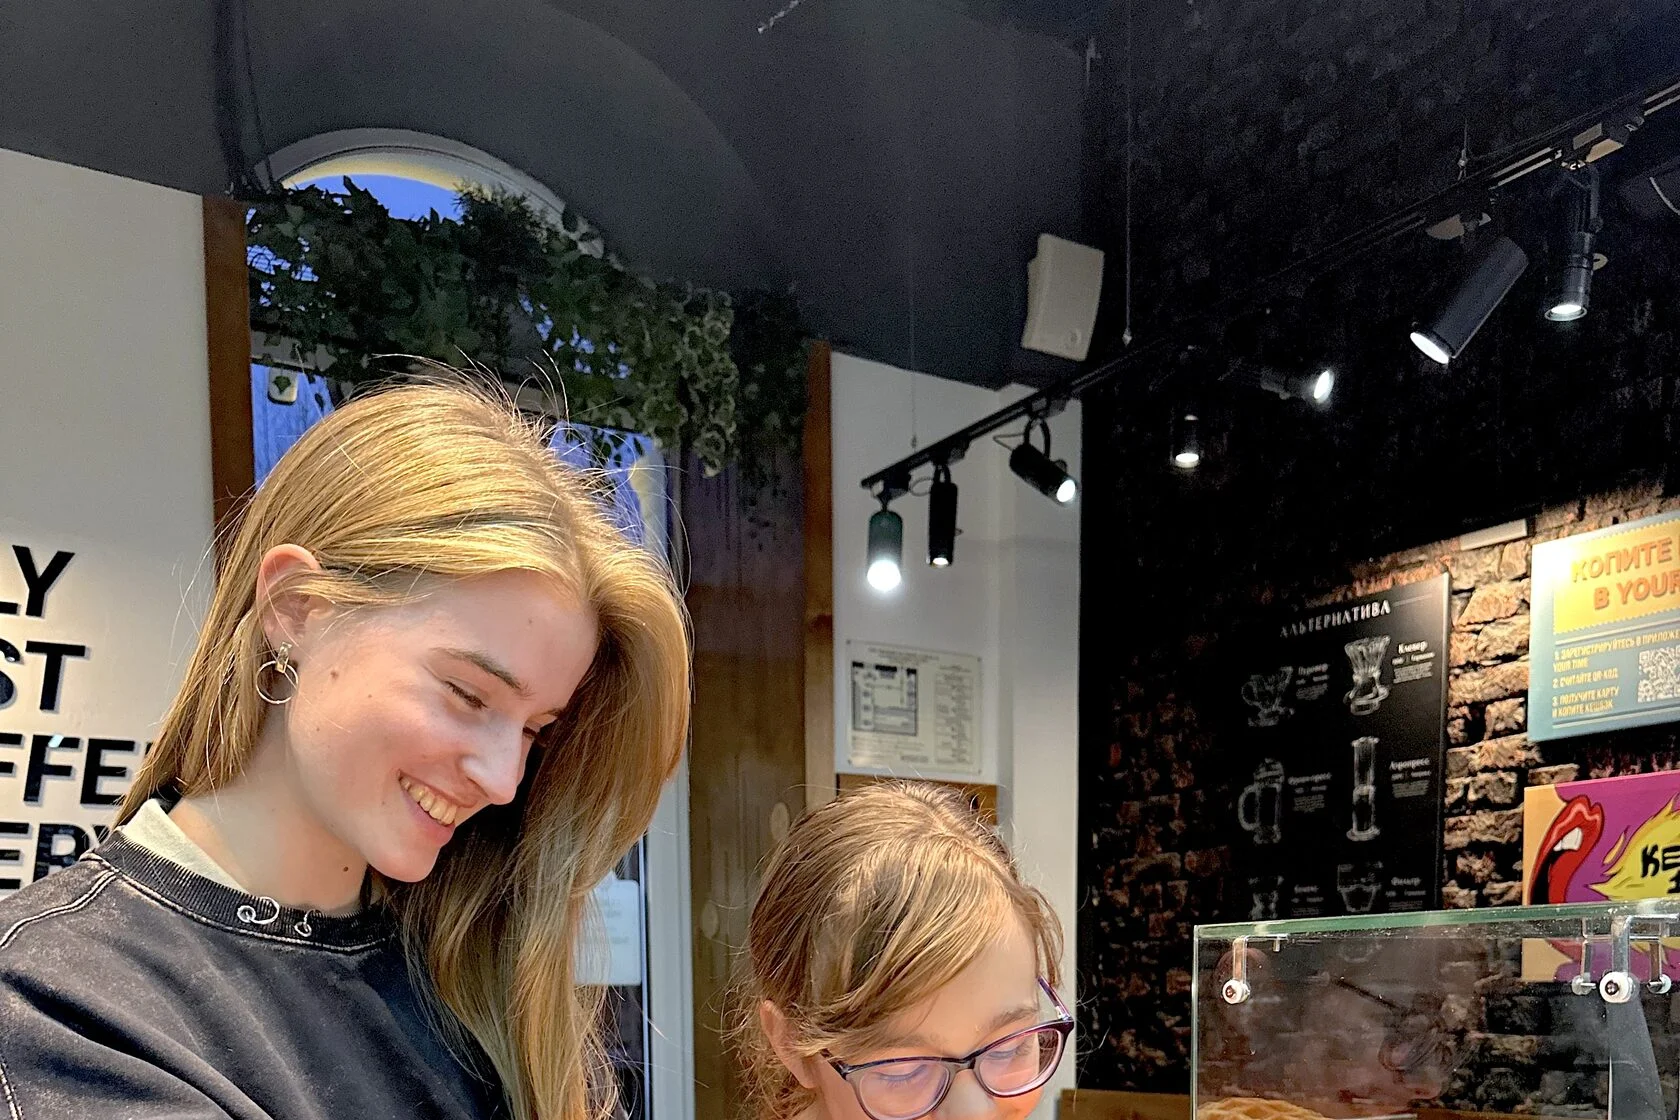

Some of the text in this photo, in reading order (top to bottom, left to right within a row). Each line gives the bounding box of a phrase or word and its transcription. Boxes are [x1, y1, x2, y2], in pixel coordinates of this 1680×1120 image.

[0, 545, 75, 618] Y
[1572, 537, 1672, 583] КОПИТЕ
[1280, 599, 1391, 639] АЛЬТЕРНАТИВА
[1642, 629, 1680, 646] ПРИЛОЖЕ
